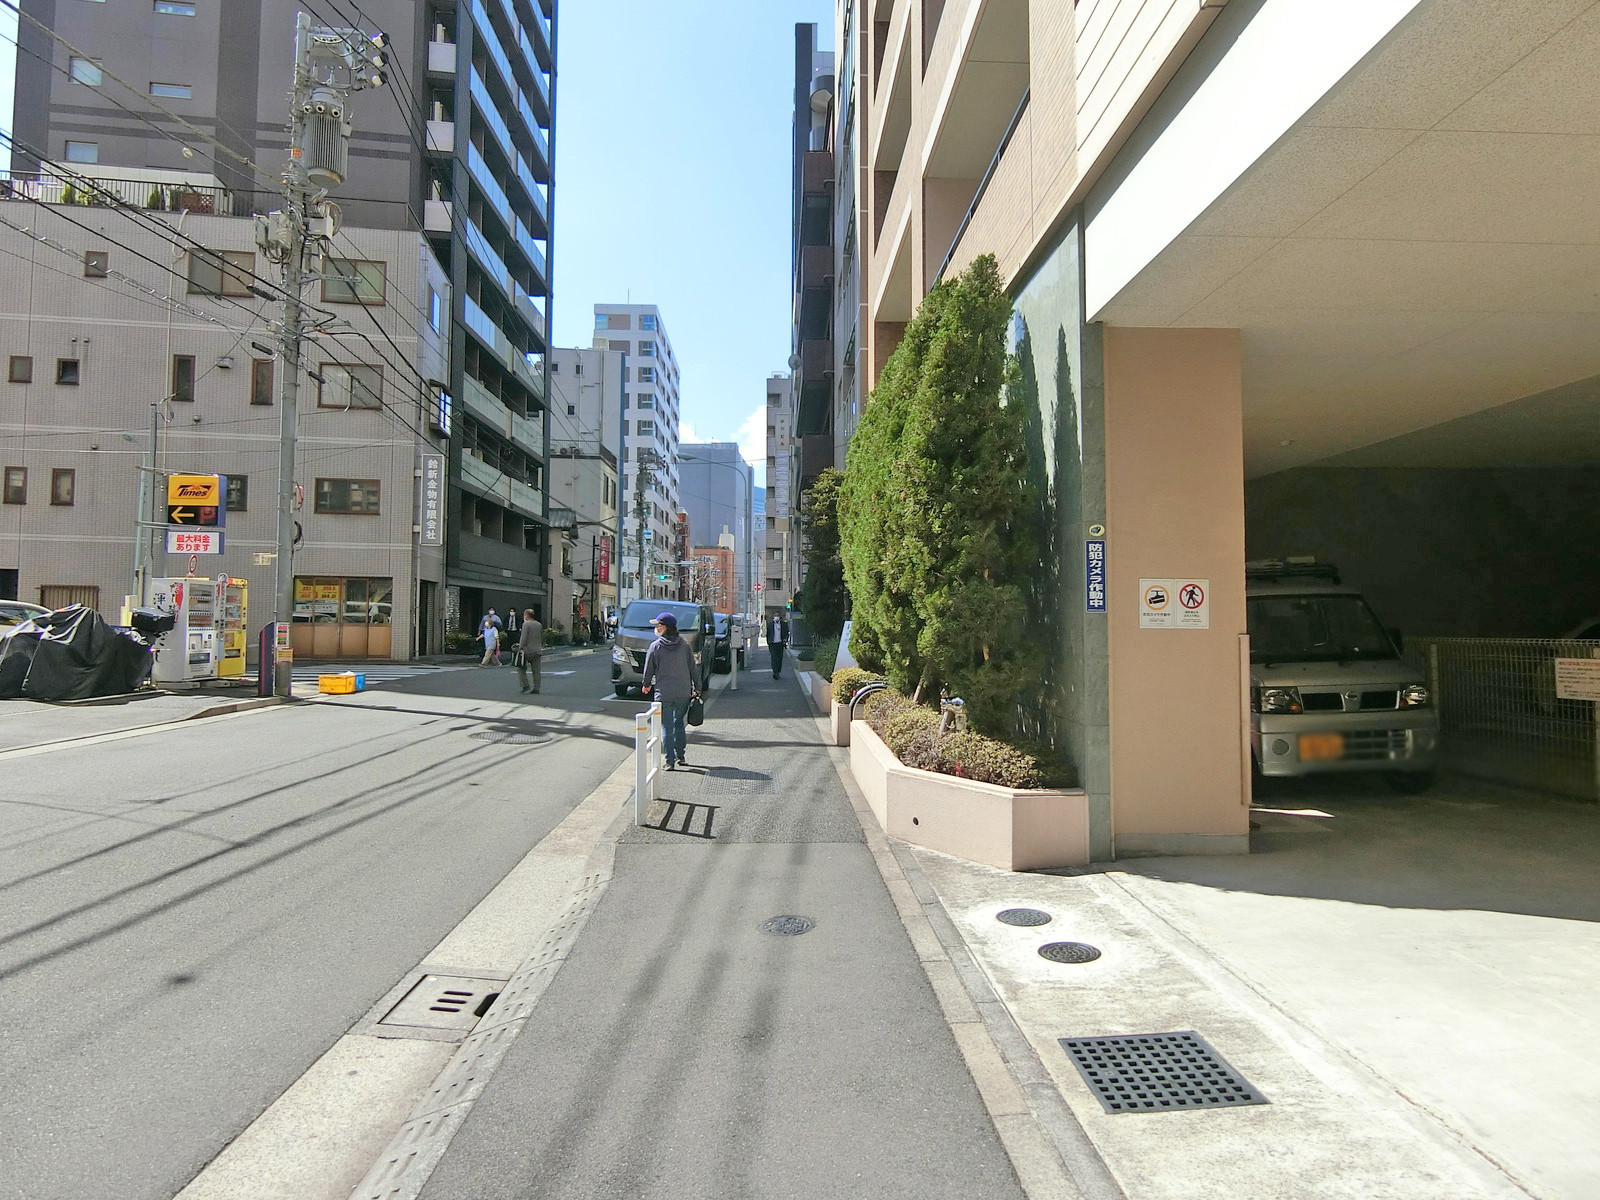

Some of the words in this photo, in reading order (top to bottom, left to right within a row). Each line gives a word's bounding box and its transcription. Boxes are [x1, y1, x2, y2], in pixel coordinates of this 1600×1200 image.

[178, 484, 212, 497] Times
[176, 534, 210, 543] 最大料金
[176, 543, 210, 552] あります
[1088, 543, 1104, 608] 防犯カメラ作動中
